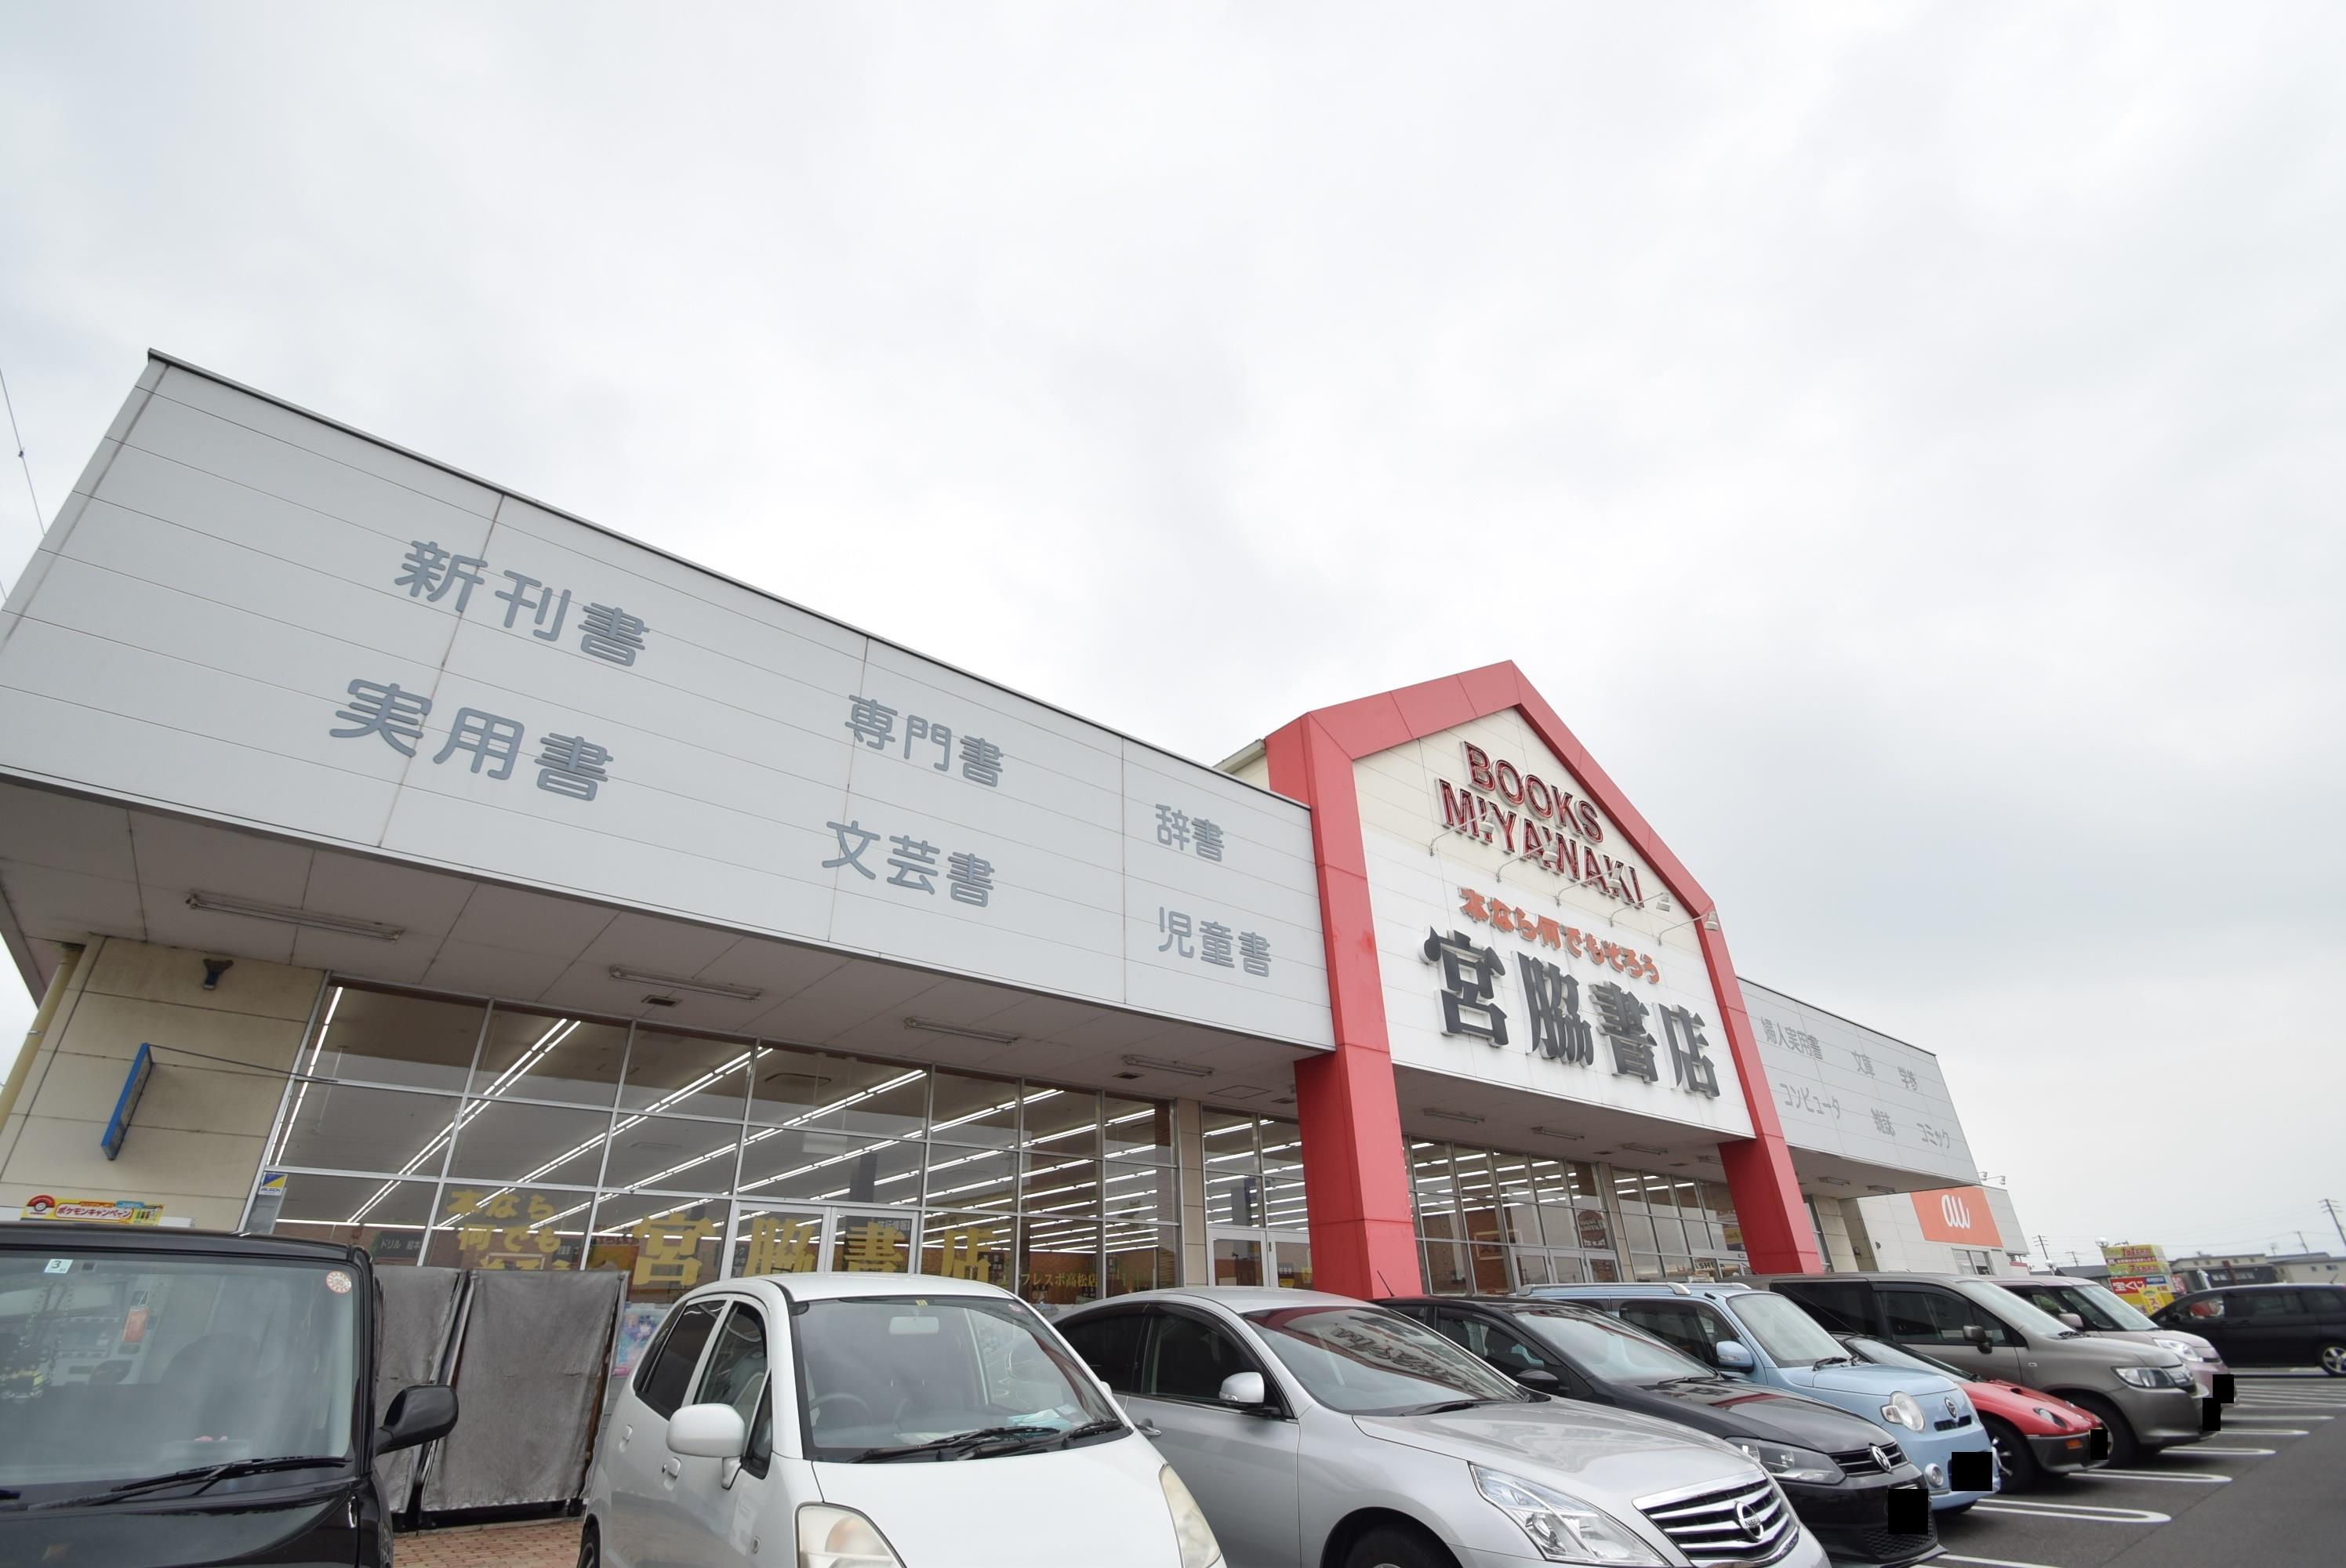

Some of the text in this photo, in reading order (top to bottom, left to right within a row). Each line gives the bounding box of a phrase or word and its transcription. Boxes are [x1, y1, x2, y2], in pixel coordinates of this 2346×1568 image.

[394, 540, 650, 666] 新刊書
[329, 678, 614, 801] 実用書
[844, 694, 1004, 787] 専門書
[1460, 740, 1603, 844] BOOKS
[822, 820, 995, 908] 文芸書
[1155, 804, 1224, 862] 辞書
[1158, 906, 1272, 977] 児童書
[1458, 886, 1660, 984] 本なら何でもそろう
[1419, 925, 1720, 1098] 宮脇書店
[1761, 1017, 1823, 1060] 婦人実用書
[1916, 1123, 1951, 1149] コミック
[56, 1206, 132, 1218] ポケモンキャンペーン
[447, 1190, 554, 1220] 本なら
[456, 1223, 561, 1253] 何でも
[51, 1260, 62, 1269] 3
